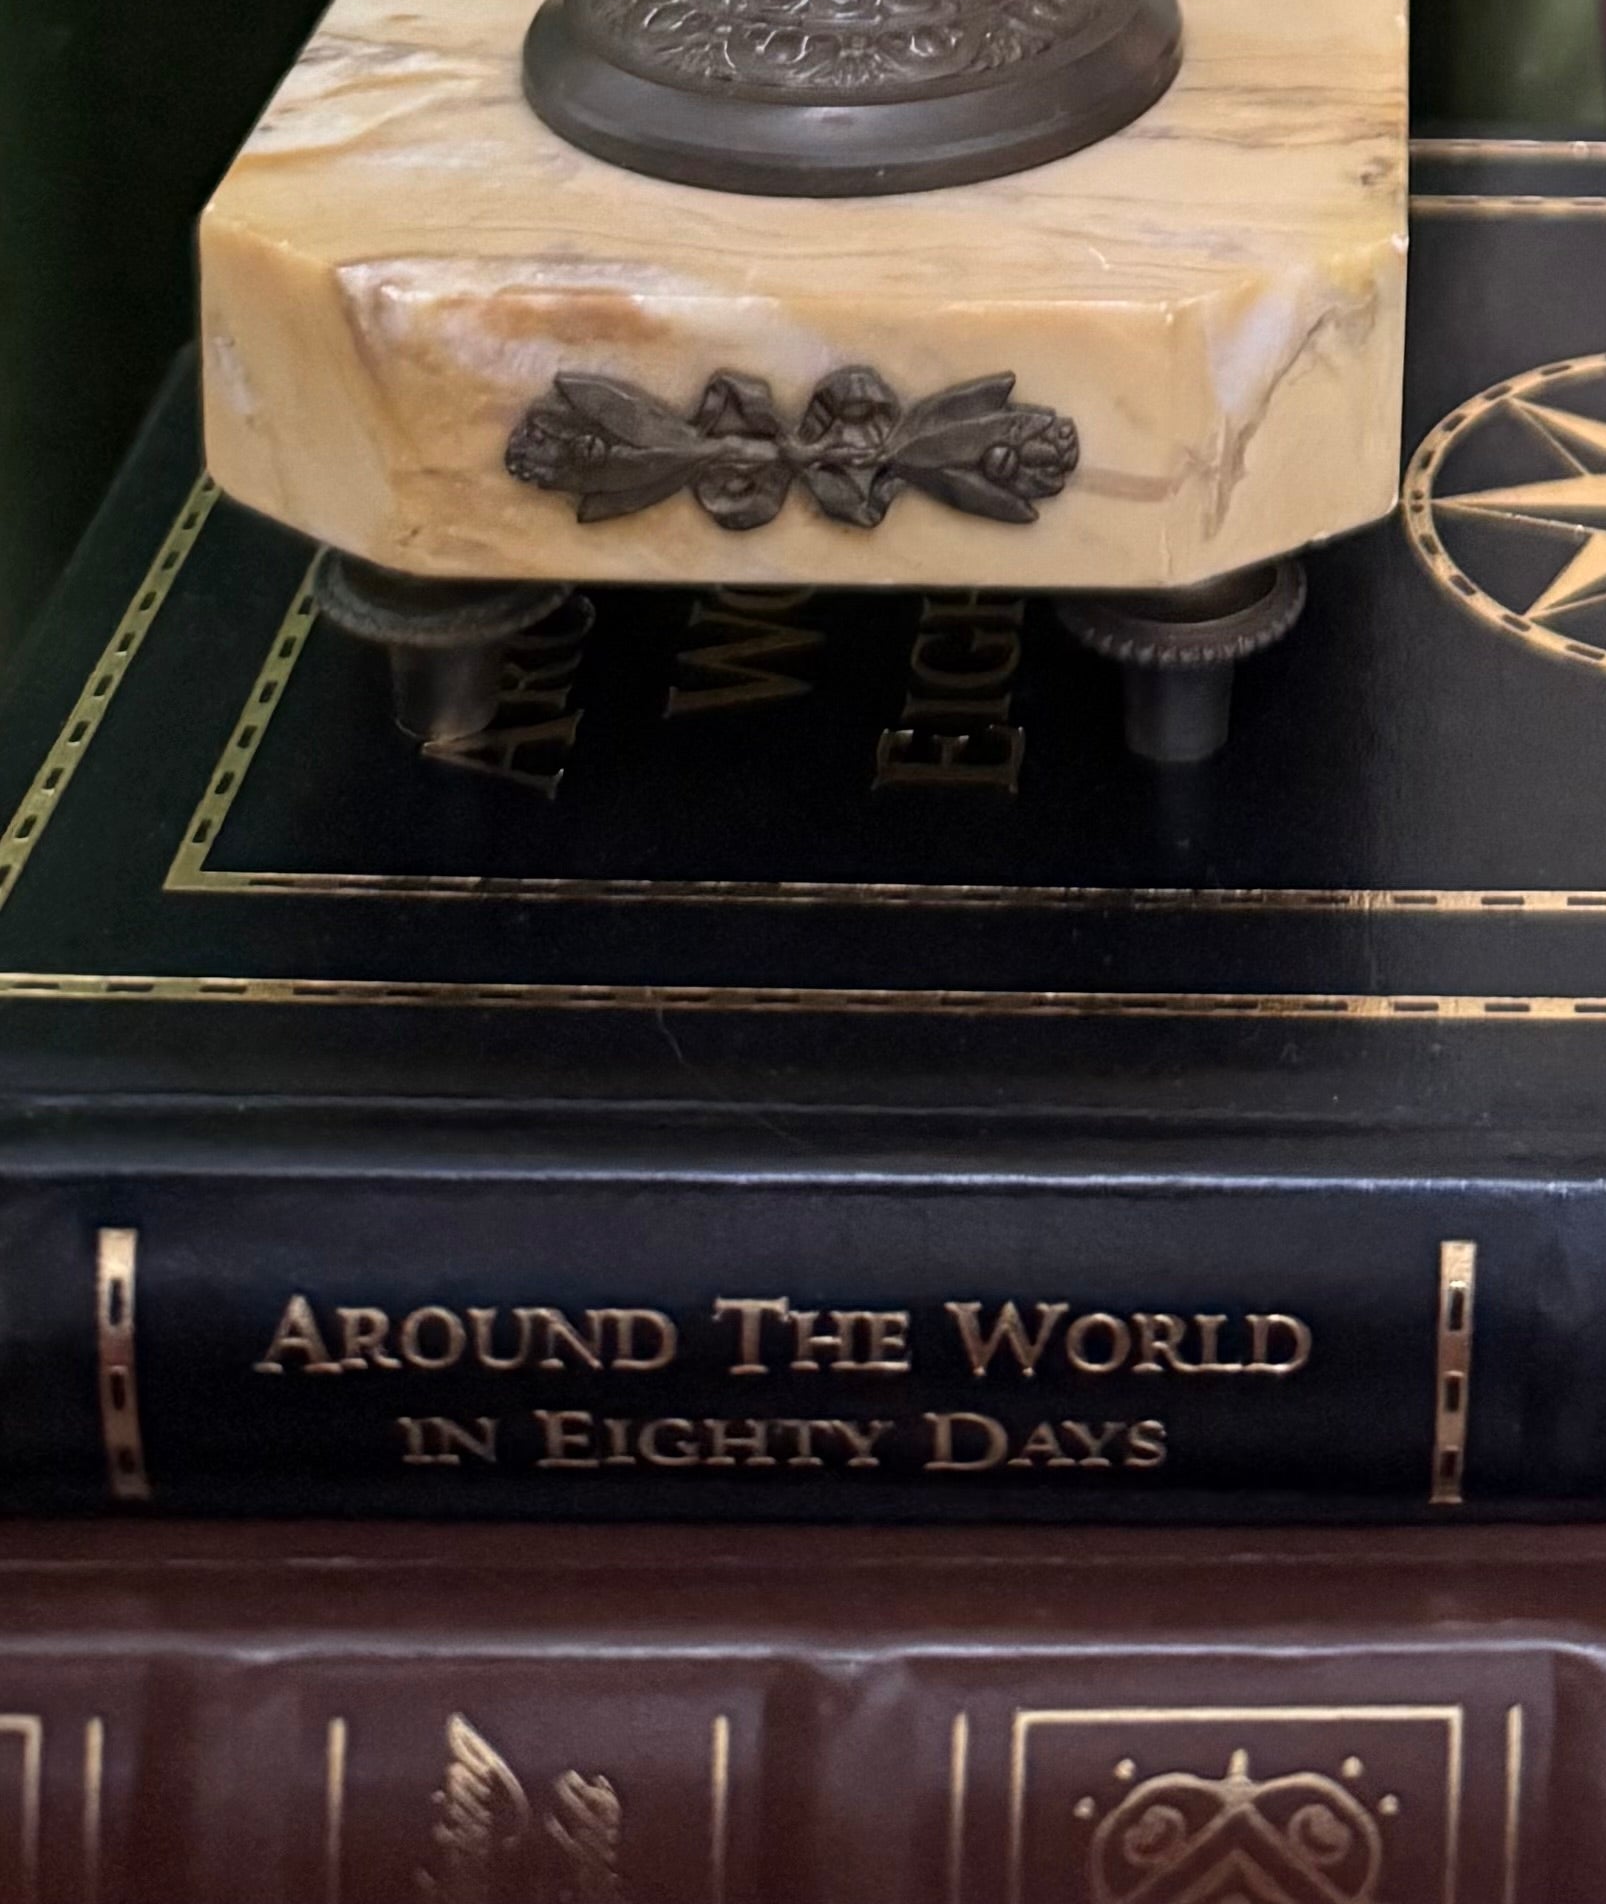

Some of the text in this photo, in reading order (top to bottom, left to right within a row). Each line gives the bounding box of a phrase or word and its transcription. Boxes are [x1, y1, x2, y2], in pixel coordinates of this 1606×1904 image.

[251, 1293, 1312, 1377] AROUND THE WORLD
[396, 1407, 1170, 1471] IN EIGHTY DAYS
